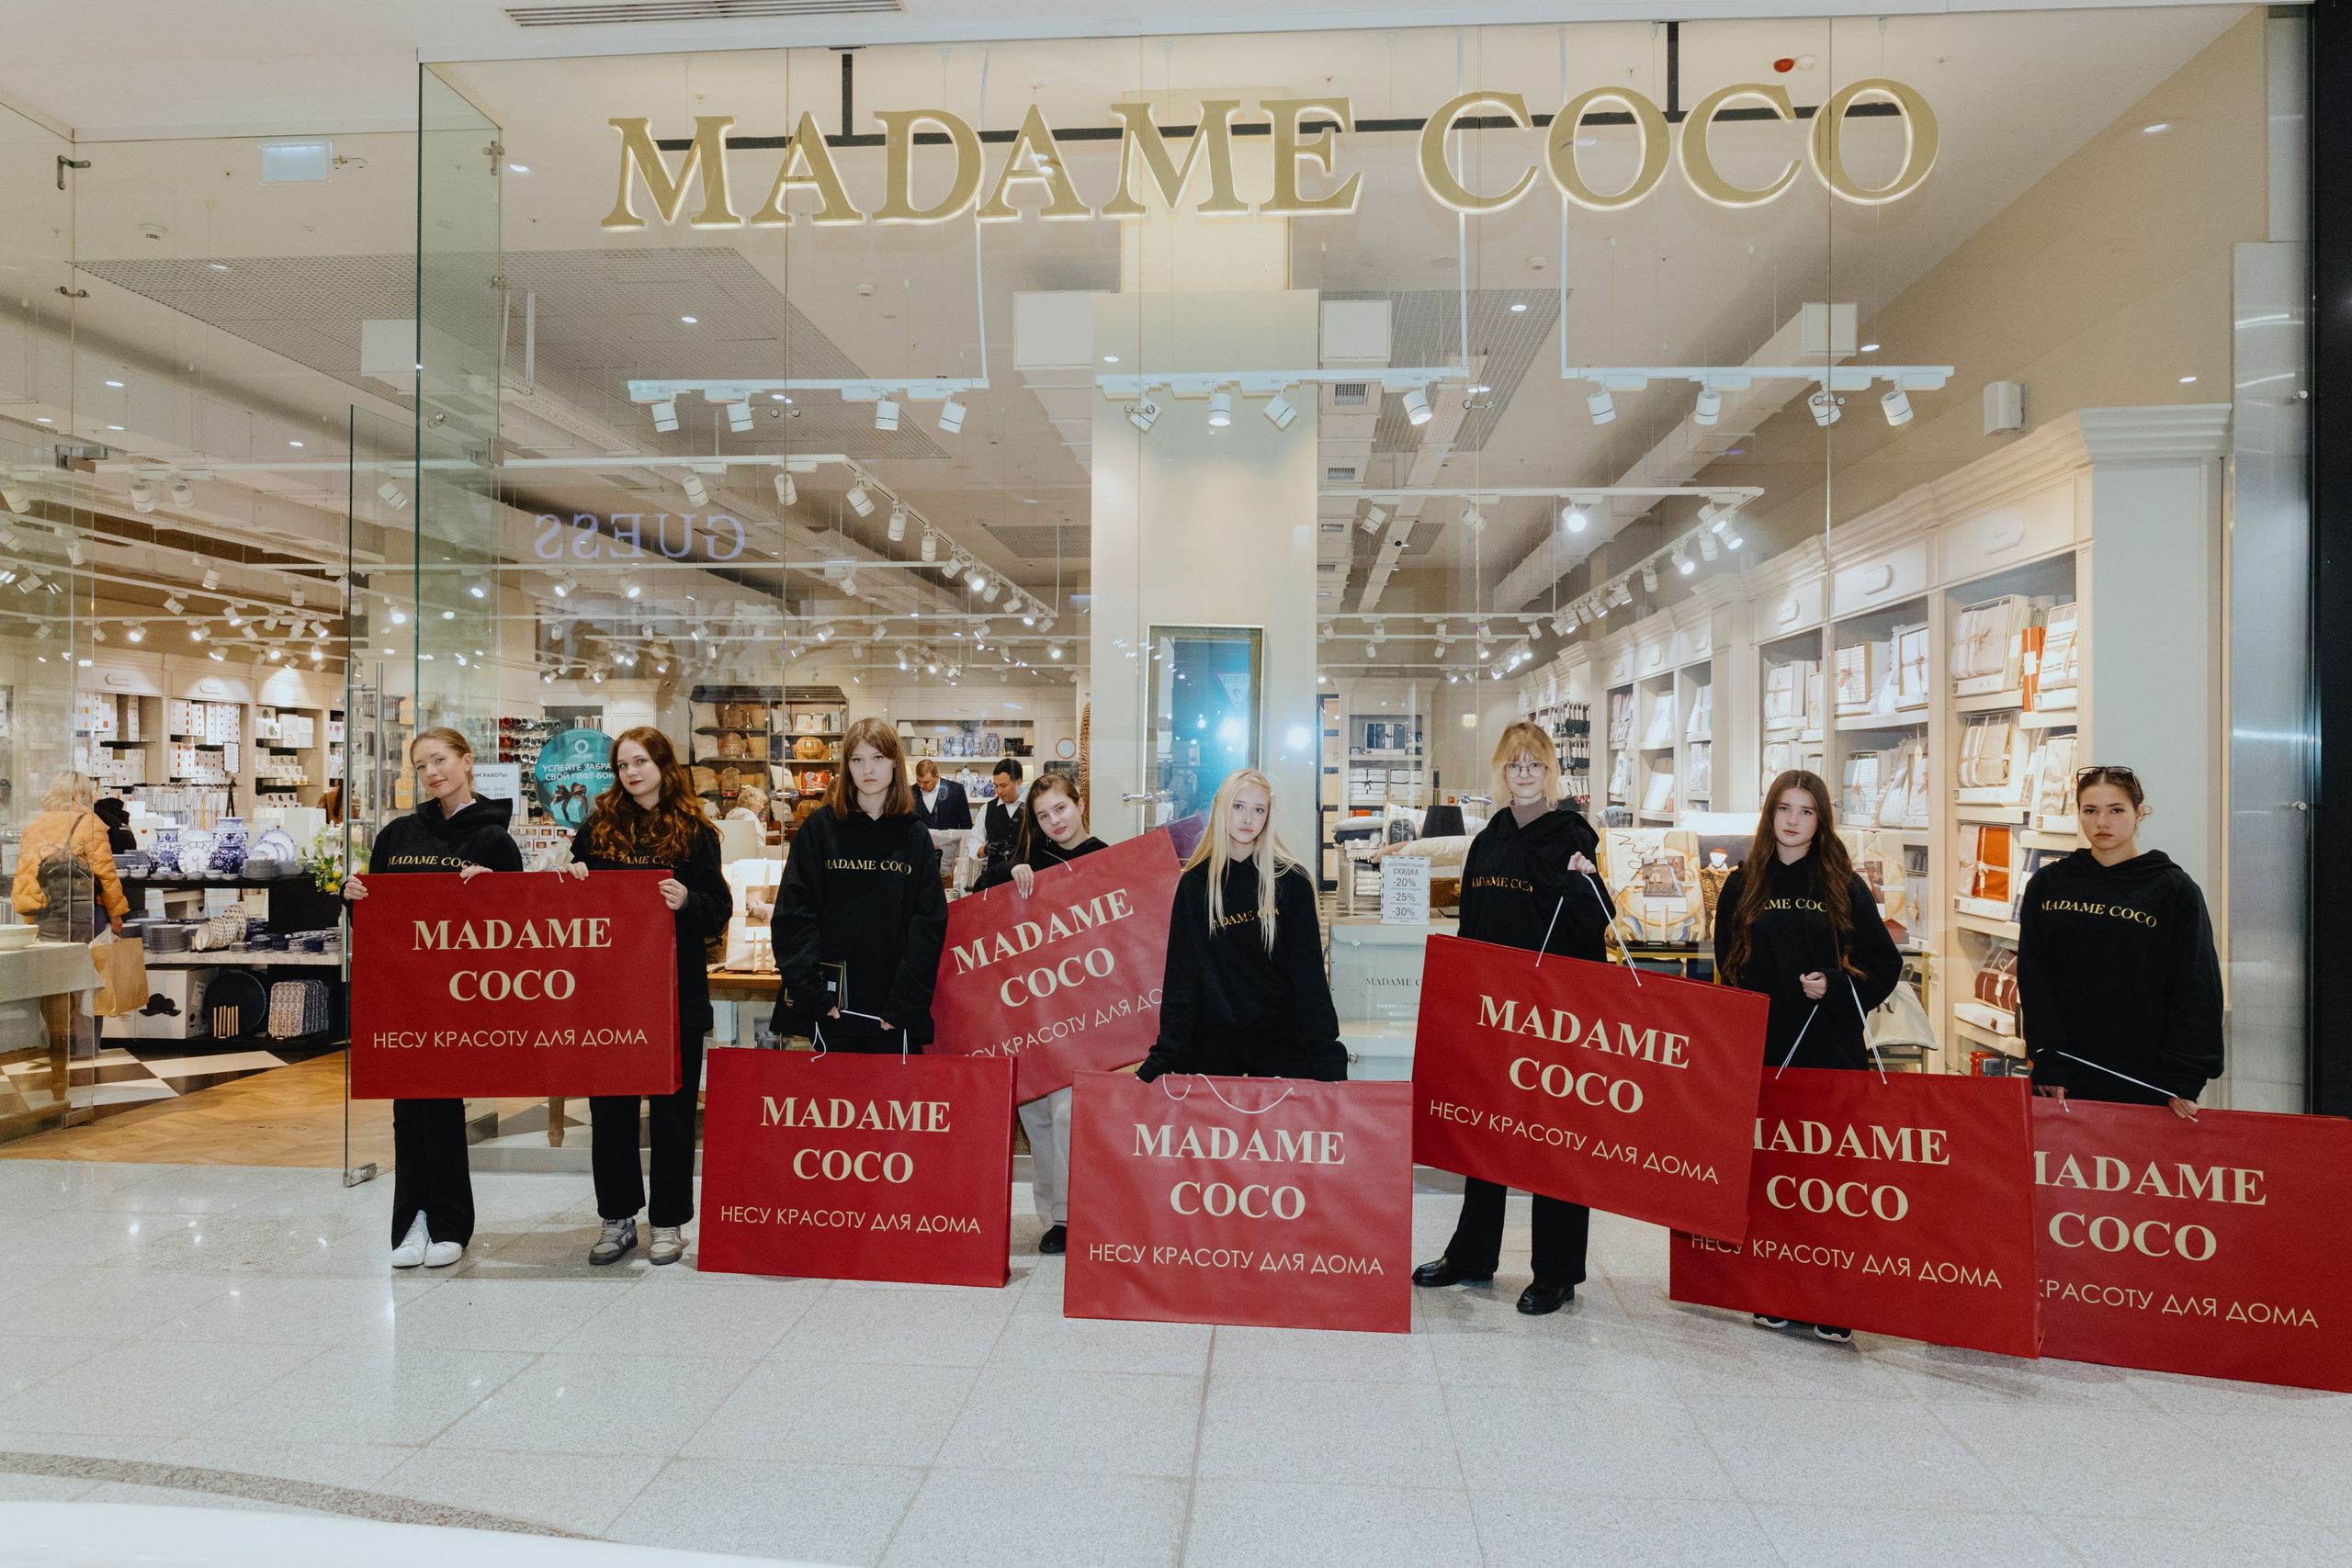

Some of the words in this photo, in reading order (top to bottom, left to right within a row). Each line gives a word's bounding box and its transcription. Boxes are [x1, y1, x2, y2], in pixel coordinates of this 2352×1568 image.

[601, 97, 1363, 229] MADAME
[1417, 77, 1939, 215] COCO
[543, 763, 582, 772] УСПЕЙТЕ
[545, 772, 570, 781] СВОЙ
[571, 772, 616, 780] ГИФТ-БОК
[441, 856, 481, 868] COC
[1393, 867, 1419, 875] СКИДКА
[1393, 877, 1416, 887] -20%
[1393, 892, 1416, 902] -25%
[1472, 876, 1509, 887] ADAME
[1212, 910, 1255, 930] ADAME
[1392, 907, 1416, 917] -30%
[1795, 897, 1828, 912] COC
[2041, 900, 2106, 915] MADAME
[2109, 906, 2157, 928] COCO
[412, 917, 613, 951] MADAME
[950, 887, 1135, 976] MADAME
[448, 968, 576, 1002] COCO
[1000, 947, 1115, 1008] COCO
[1365, 977, 1412, 987] MADAME
[373, 1031, 428, 1049] НЕСУ
[434, 1030, 529, 1048] КРАСОТУ
[533, 1029, 575, 1048] ДЛЯ
[581, 1028, 649, 1047] ДОМА
[1001, 1013, 1086, 1056] КРАСОТУ
[1094, 998, 1132, 1028] ДЛЯ
[1136, 987, 1163, 1013] ДО
[1476, 994, 1690, 1069] MADAME
[1509, 1056, 1644, 1114] COCO
[759, 1096, 951, 1133] MADAME
[1132, 1123, 1346, 1165] MADAME
[1430, 1099, 1484, 1126] НЕСУ
[1488, 1112, 1588, 1151] КРАСОТУ
[1591, 1139, 1638, 1165] ДЛЯ
[1643, 1151, 1719, 1185] ДОМА
[792, 1148, 914, 1184] COCO
[1170, 1180, 1306, 1220] COCO
[1766, 1175, 1909, 1222] COCO
[720, 1205, 772, 1224] НЕСУ
[776, 1208, 866, 1229] КРАСОТУ
[870, 1213, 911, 1232] ДЛЯ
[915, 1214, 981, 1235] ДОМА
[2048, 1211, 2217, 1261] COCO
[1089, 1243, 1147, 1264] НЕСУ
[1153, 1246, 1254, 1269] КРАСОТУ
[1259, 1251, 1305, 1273] ДЛЯ
[1310, 1254, 1385, 1276] ДОМА
[1752, 1238, 1855, 1269] КРАСОТУ
[1861, 1253, 1911, 1278] ДЛЯ
[1917, 1260, 2003, 1290] ДОМА
[2161, 1293, 2217, 1317] ДЛЯ
[2225, 1301, 2319, 1329] ДОМА
